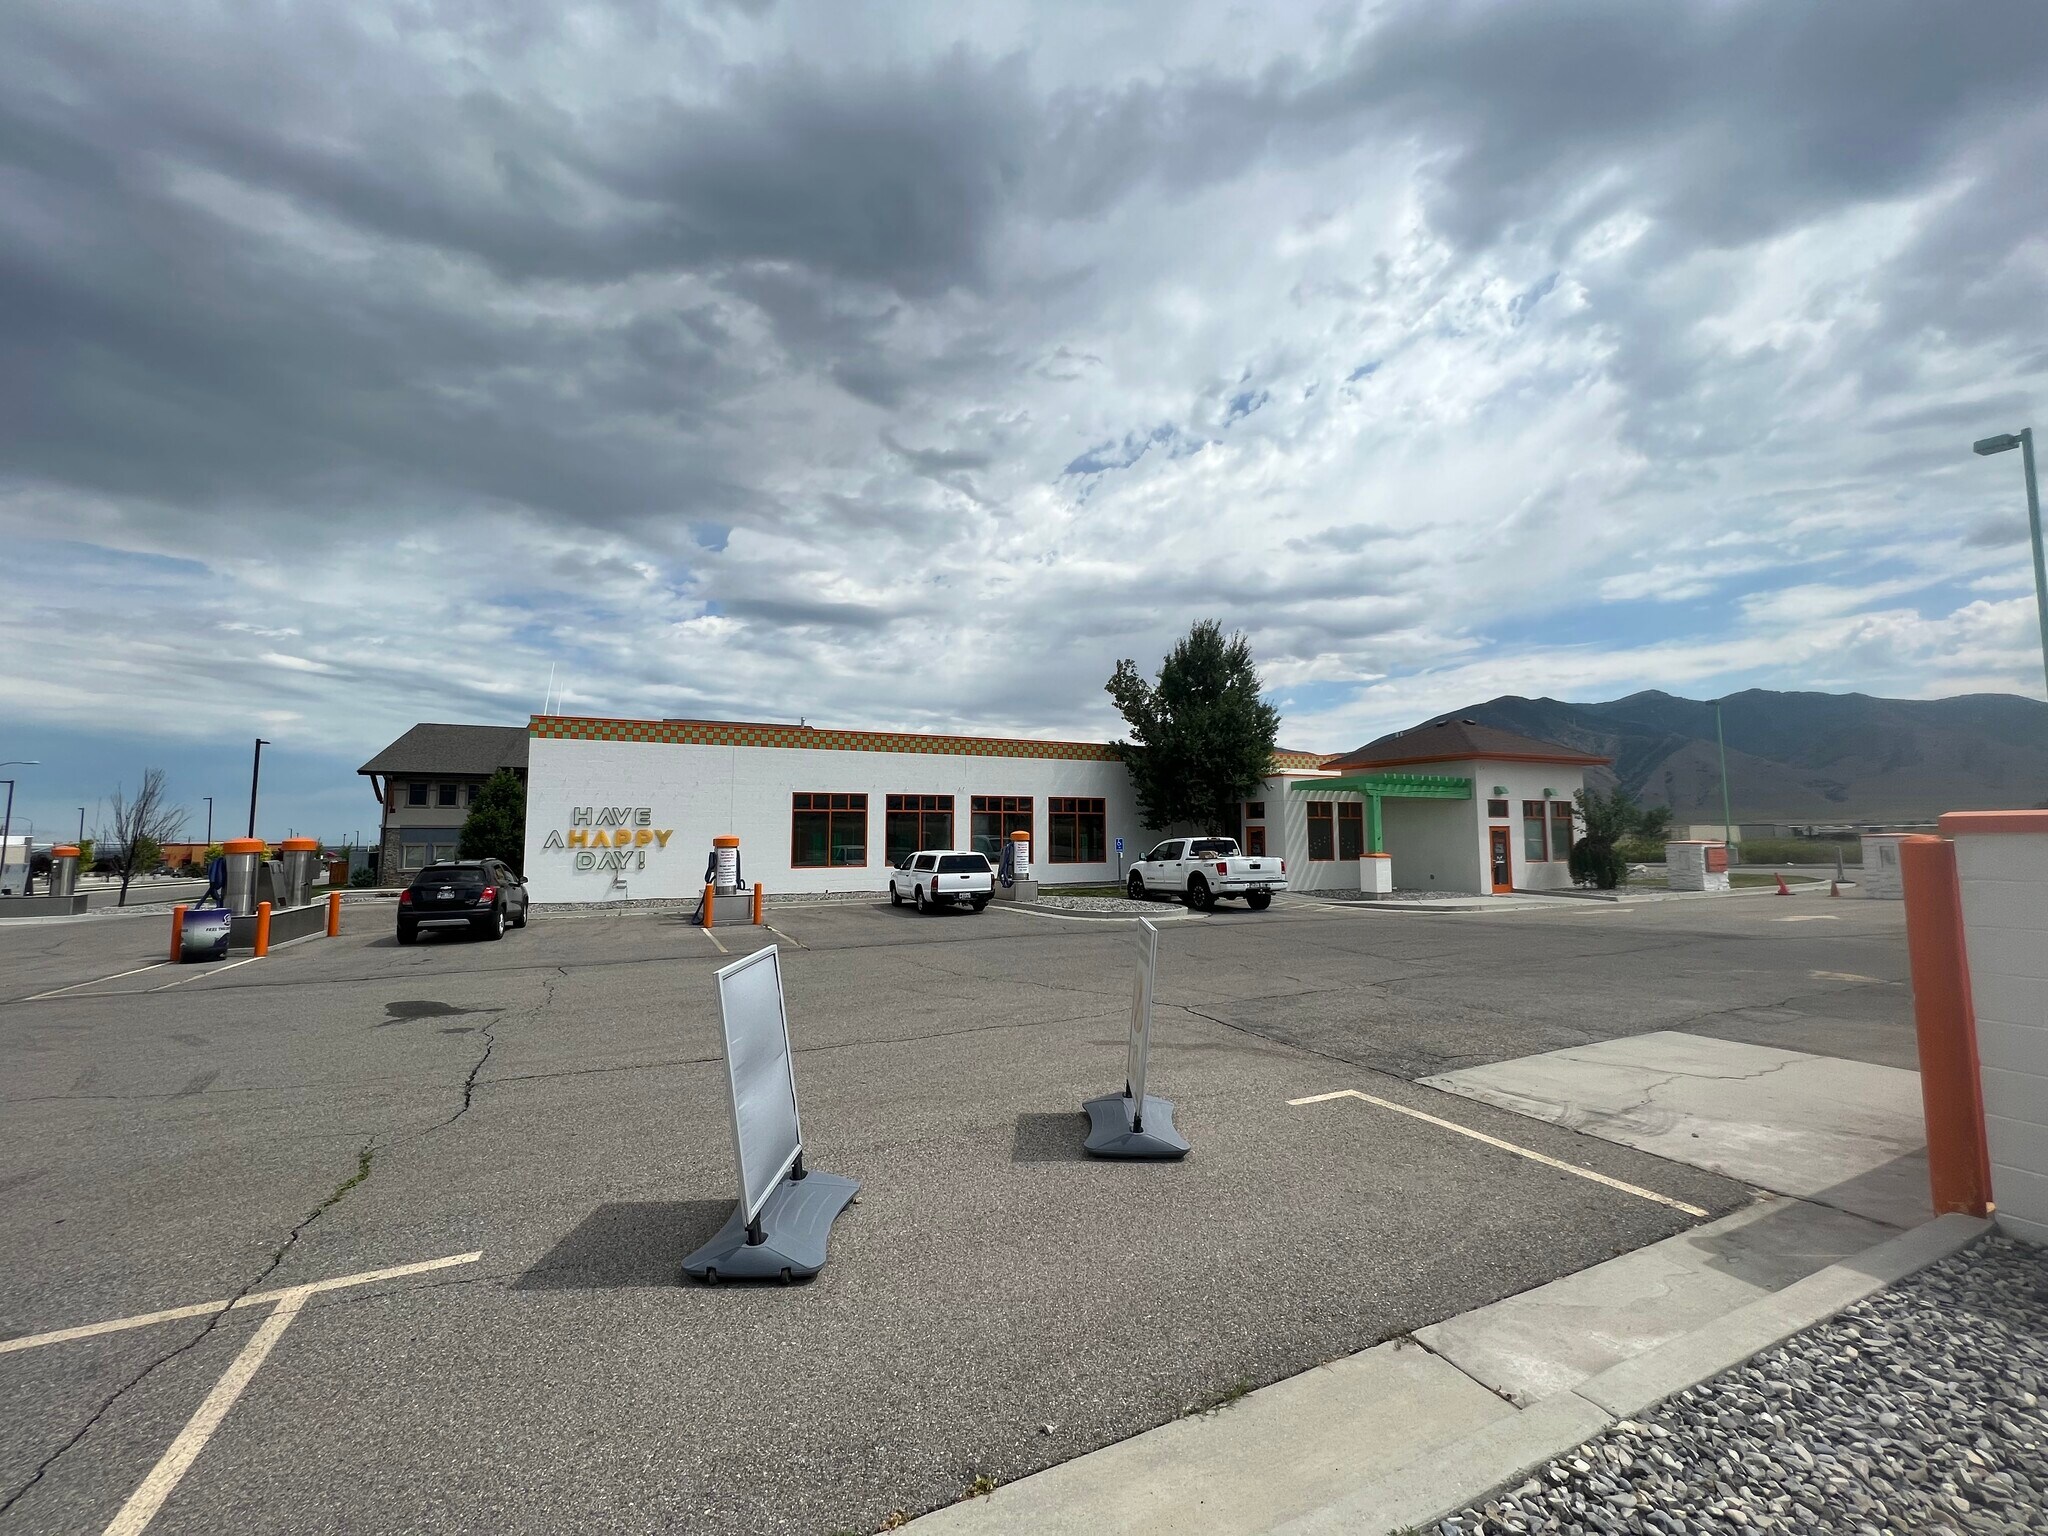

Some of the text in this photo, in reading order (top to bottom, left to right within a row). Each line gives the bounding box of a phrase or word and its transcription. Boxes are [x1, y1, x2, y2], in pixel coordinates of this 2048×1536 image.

[573, 807, 652, 826] HAVE
[567, 828, 674, 849] HAPPY
[576, 851, 646, 870] DAY!
